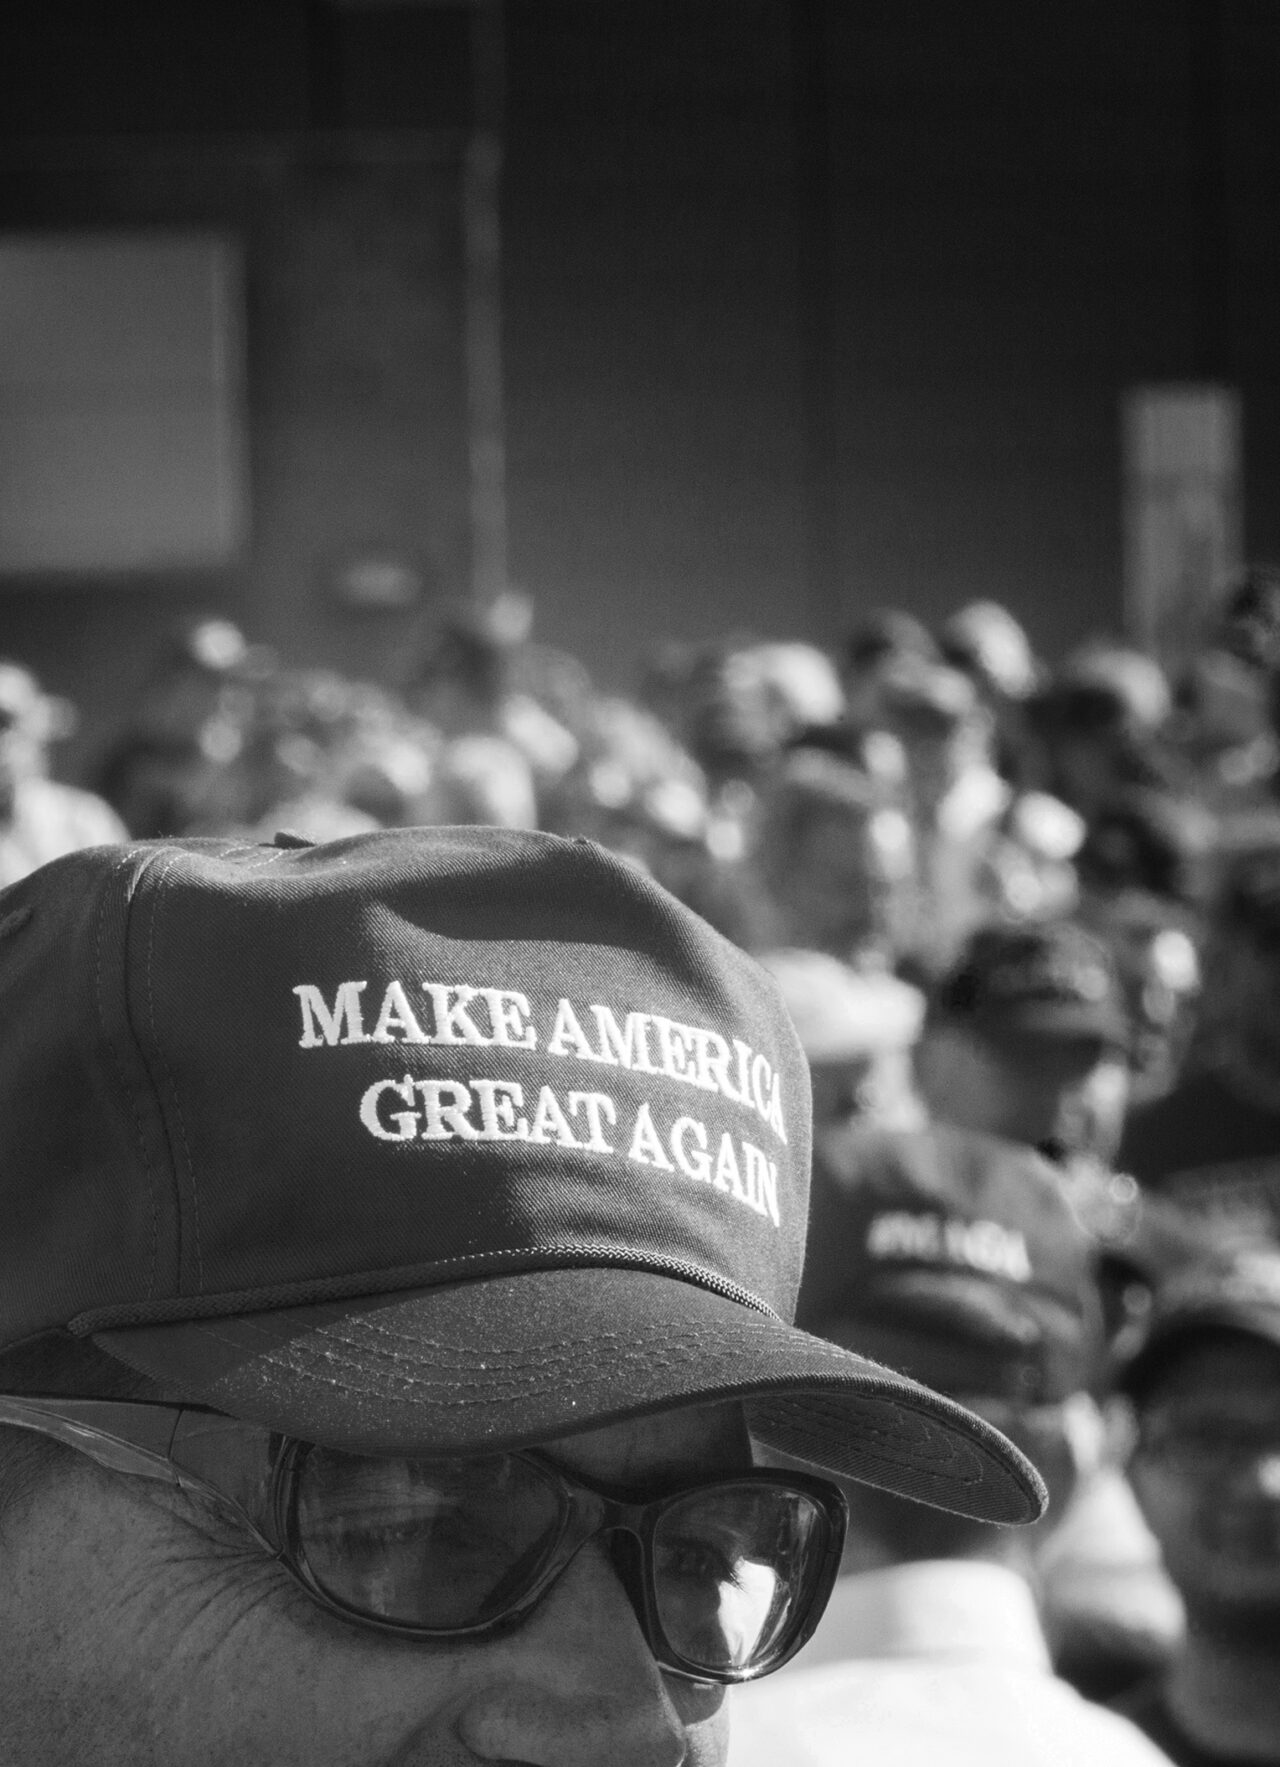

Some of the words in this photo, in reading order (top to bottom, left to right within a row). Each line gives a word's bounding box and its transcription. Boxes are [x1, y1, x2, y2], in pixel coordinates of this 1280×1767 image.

[293, 980, 536, 1050] MAKE
[548, 999, 787, 1145] AMERICA
[359, 1074, 615, 1154] GREAT
[628, 1103, 780, 1228] AGAIN
